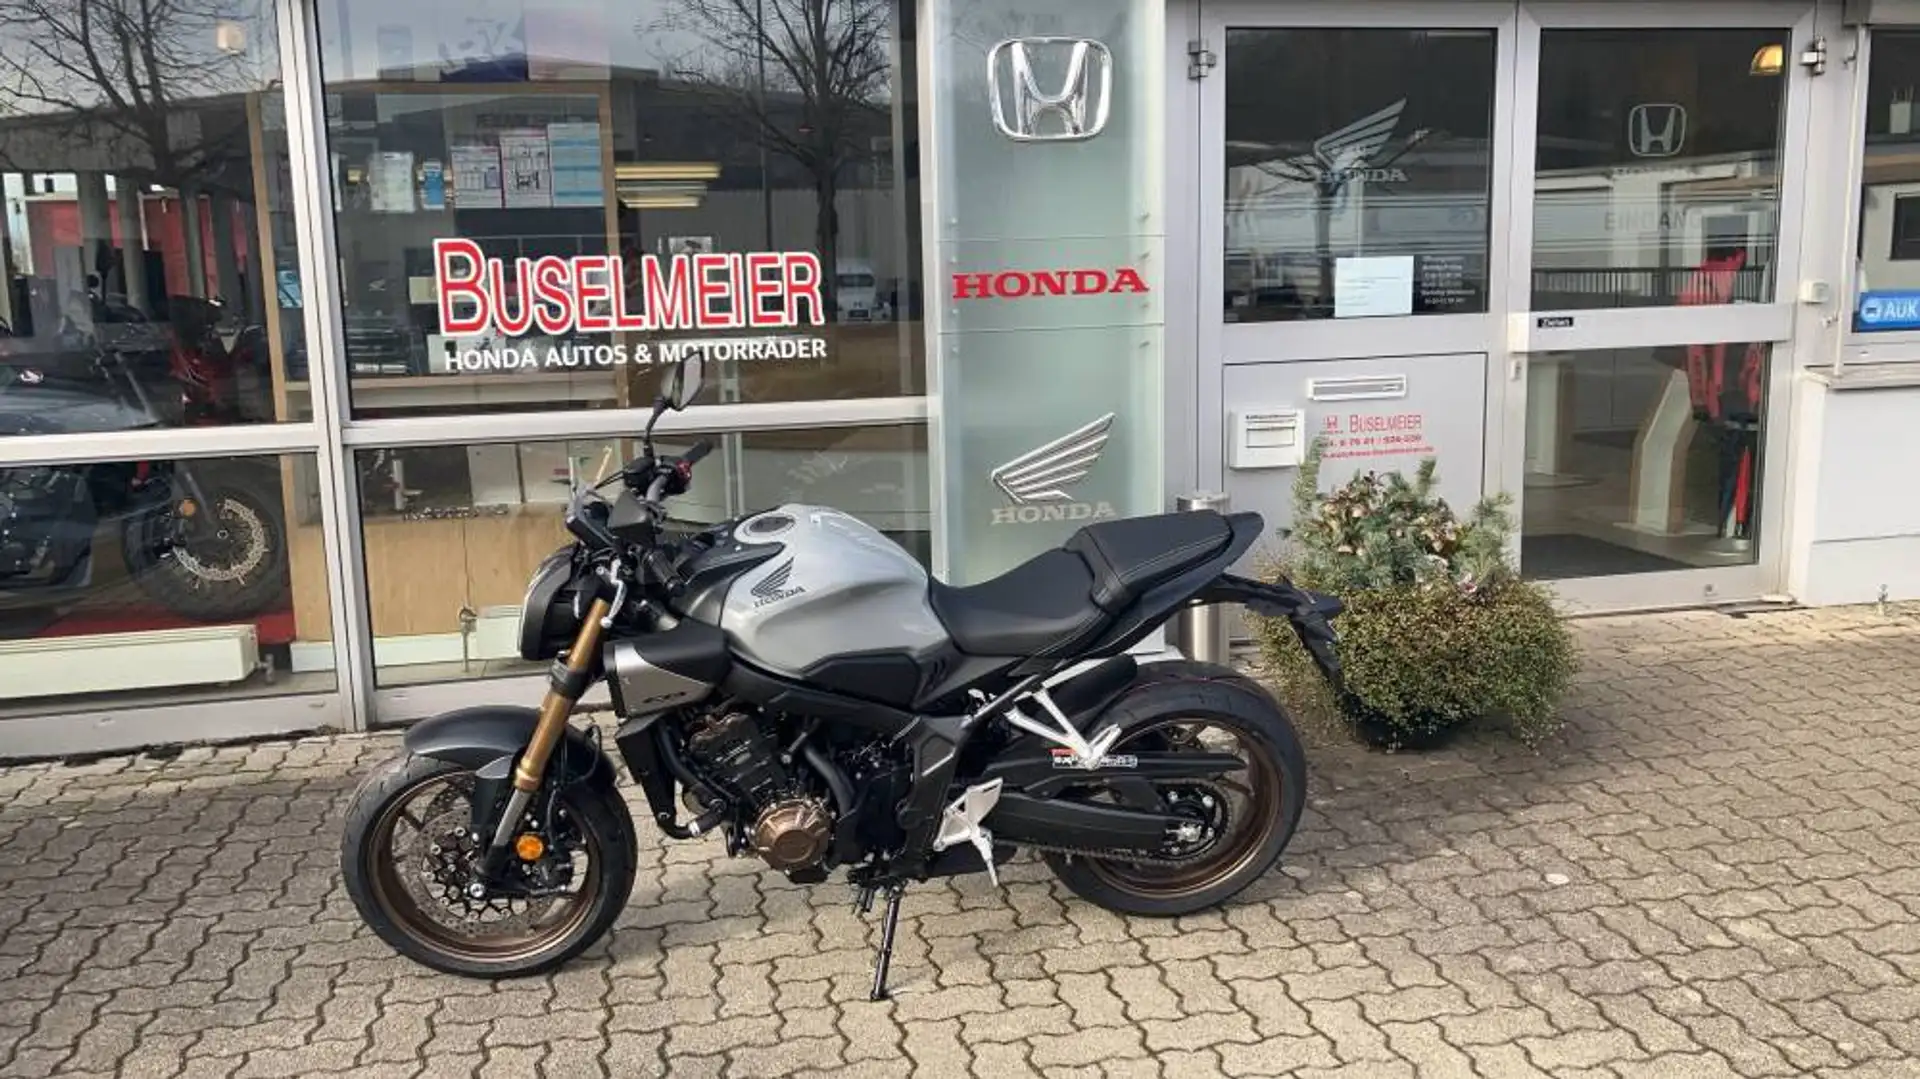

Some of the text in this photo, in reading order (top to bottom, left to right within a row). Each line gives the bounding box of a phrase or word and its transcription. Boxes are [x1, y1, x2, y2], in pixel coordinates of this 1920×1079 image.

[433, 238, 825, 337] BUSELMEIER
[952, 267, 1151, 299] HONDA
[445, 350, 538, 370] HONDA
[544, 345, 628, 367] AUTOS
[634, 343, 652, 364] &
[1349, 414, 1422, 433] BUSELMEIER
[992, 502, 1116, 525] HONDA
